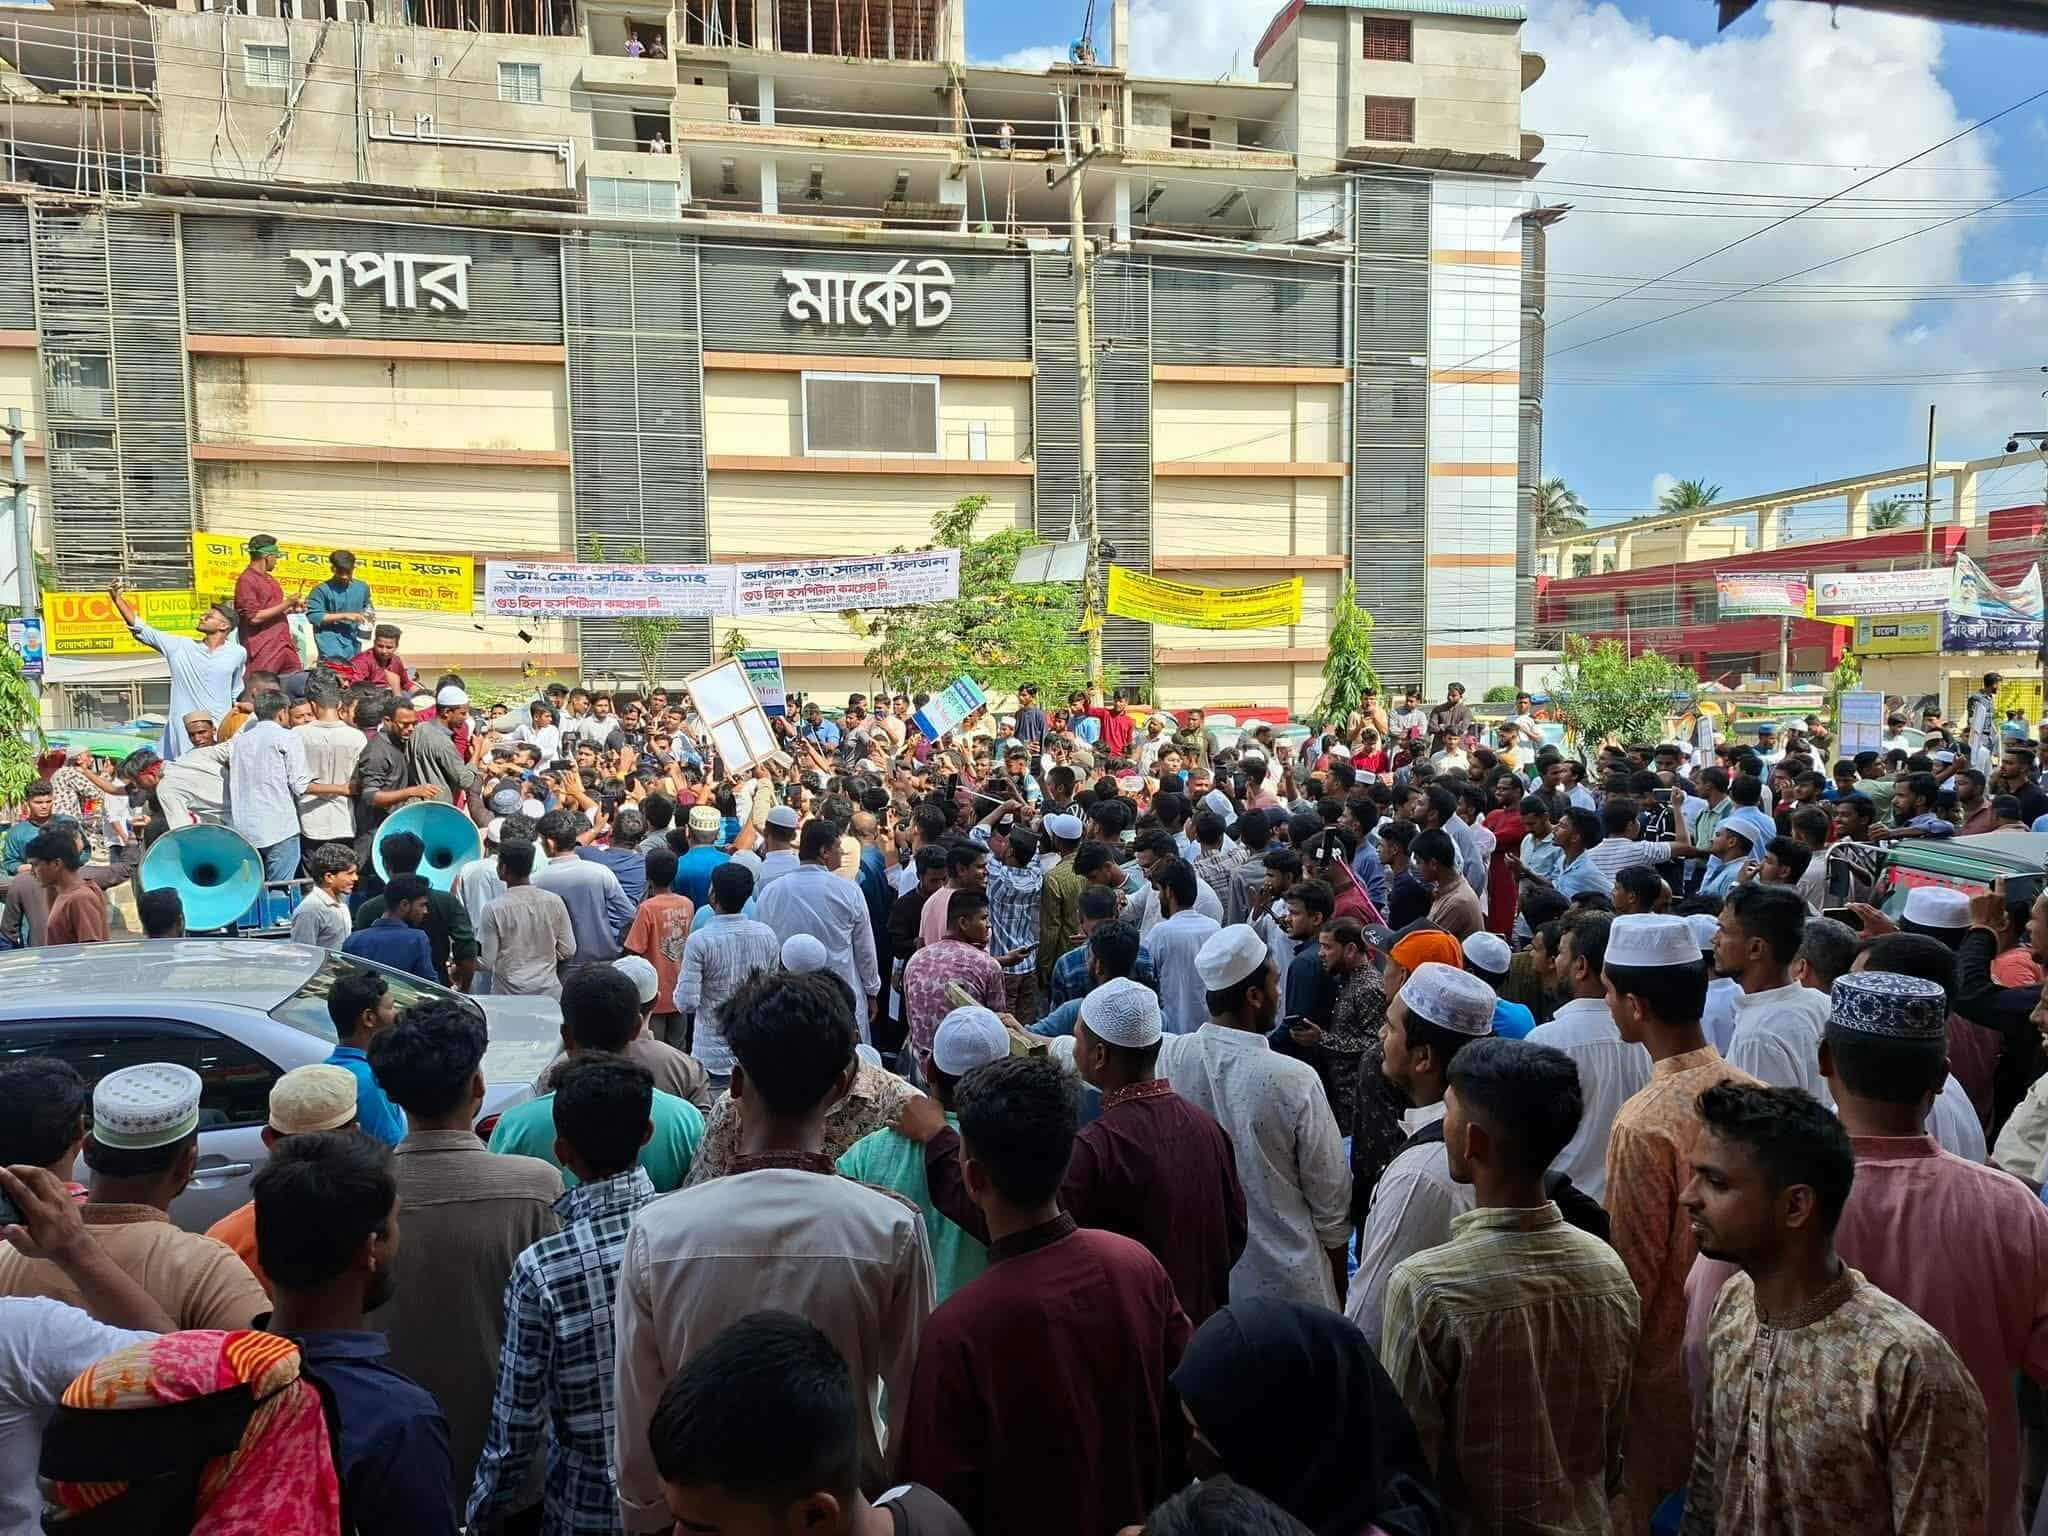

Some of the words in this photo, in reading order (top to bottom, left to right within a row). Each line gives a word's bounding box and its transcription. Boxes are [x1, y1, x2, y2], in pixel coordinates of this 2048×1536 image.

[288, 249, 472, 330] সুপার
[782, 259, 956, 327] মার্কেট
[409, 561, 463, 577] সুজন
[742, 569, 800, 580] অধ্যাপক
[833, 561, 883, 575] সালমা
[889, 557, 951, 572] সুলতানা
[764, 586, 784, 600] হিল
[787, 583, 836, 599] হসপিটাল
[149, 599, 210, 611] UNIQUE
[518, 595, 542, 609] হিল
[544, 596, 602, 609] হসপিটাল
[1949, 618, 1987, 638] মাইজদী
